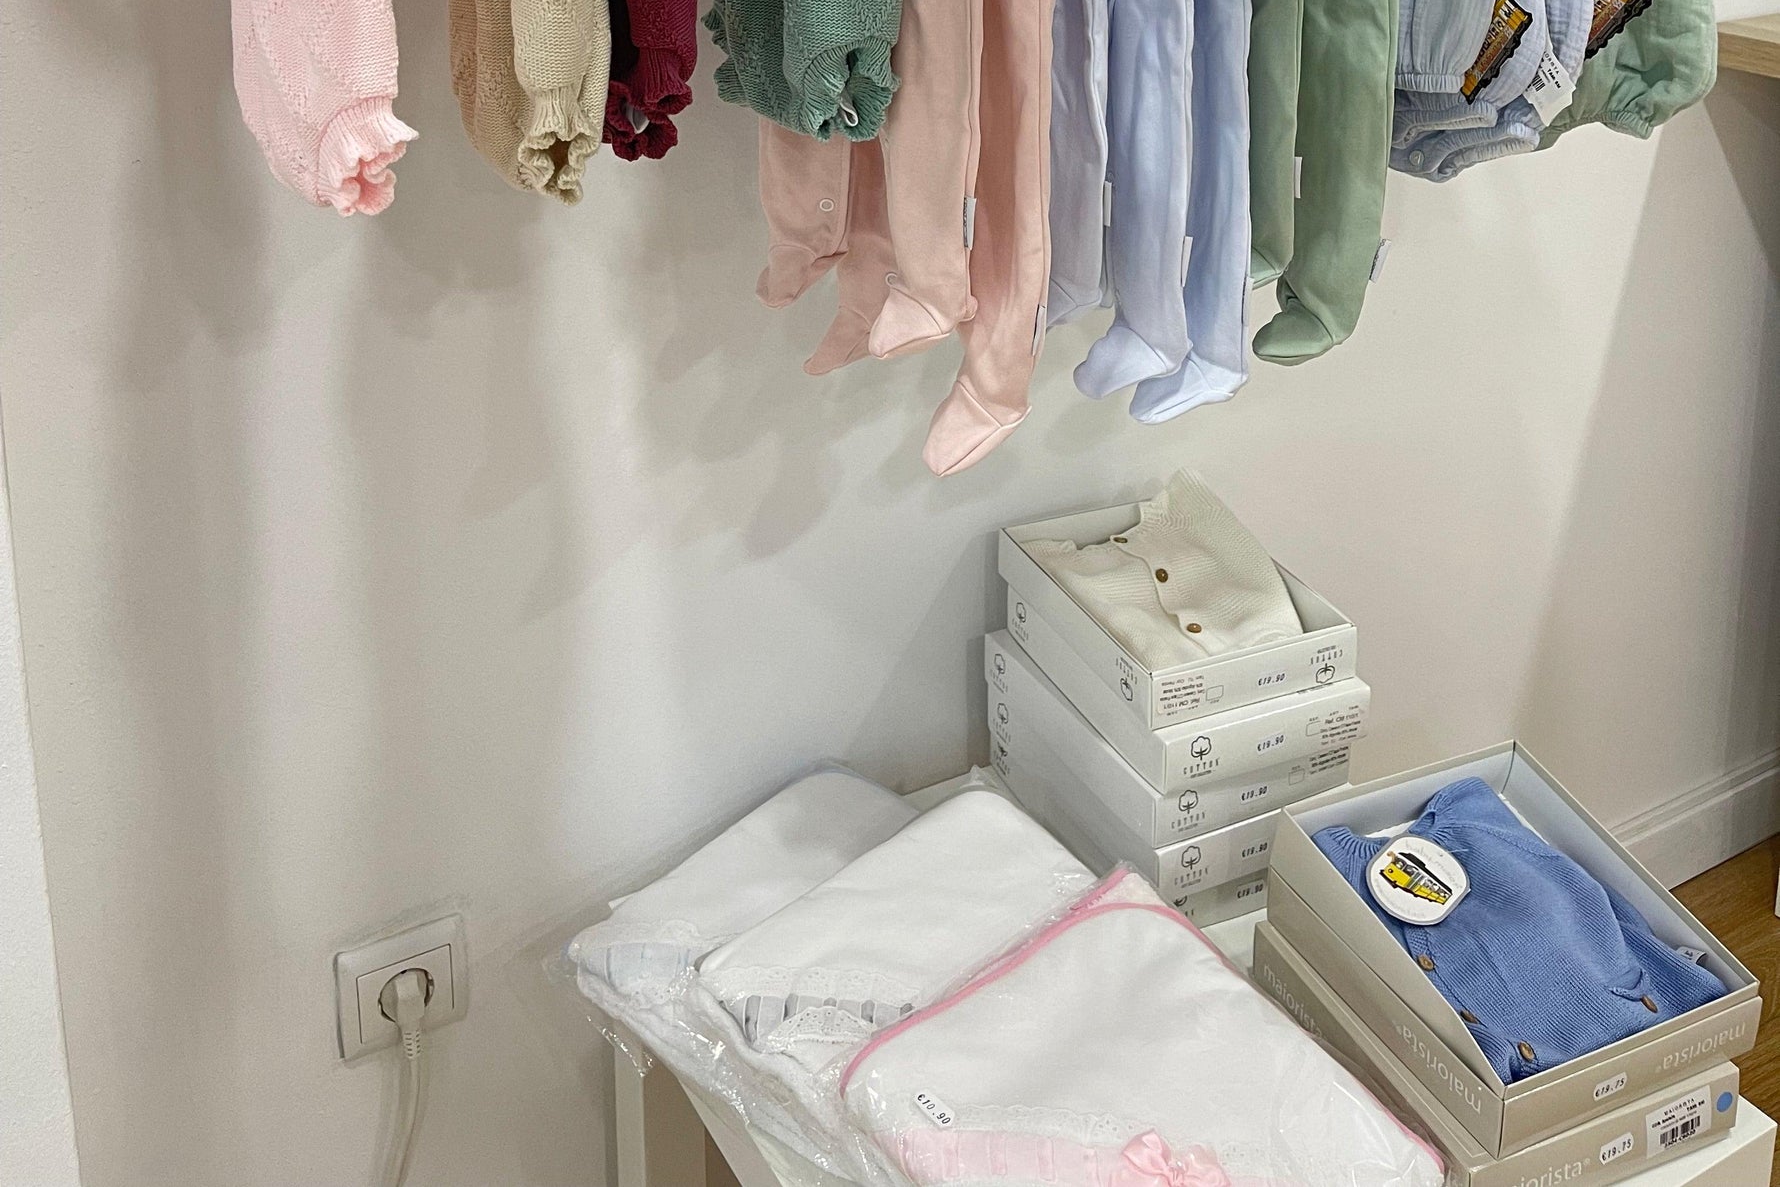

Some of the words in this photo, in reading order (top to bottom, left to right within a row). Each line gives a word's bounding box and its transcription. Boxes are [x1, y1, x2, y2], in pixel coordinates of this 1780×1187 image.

[1258, 673, 1286, 686] €19.90
[1257, 735, 1284, 752] €19.90
[1183, 758, 1220, 775] COTTON
[1241, 786, 1268, 801] €19.90
[1171, 811, 1205, 829] COTTON
[1241, 842, 1268, 858] €19.90
[1174, 866, 1208, 886] COTTON
[1237, 884, 1264, 899] €19.90
[1595, 1078, 1625, 1098] €19.75
[917, 1093, 951, 1125] €10.90
[1601, 1139, 1632, 1162] €19.75
